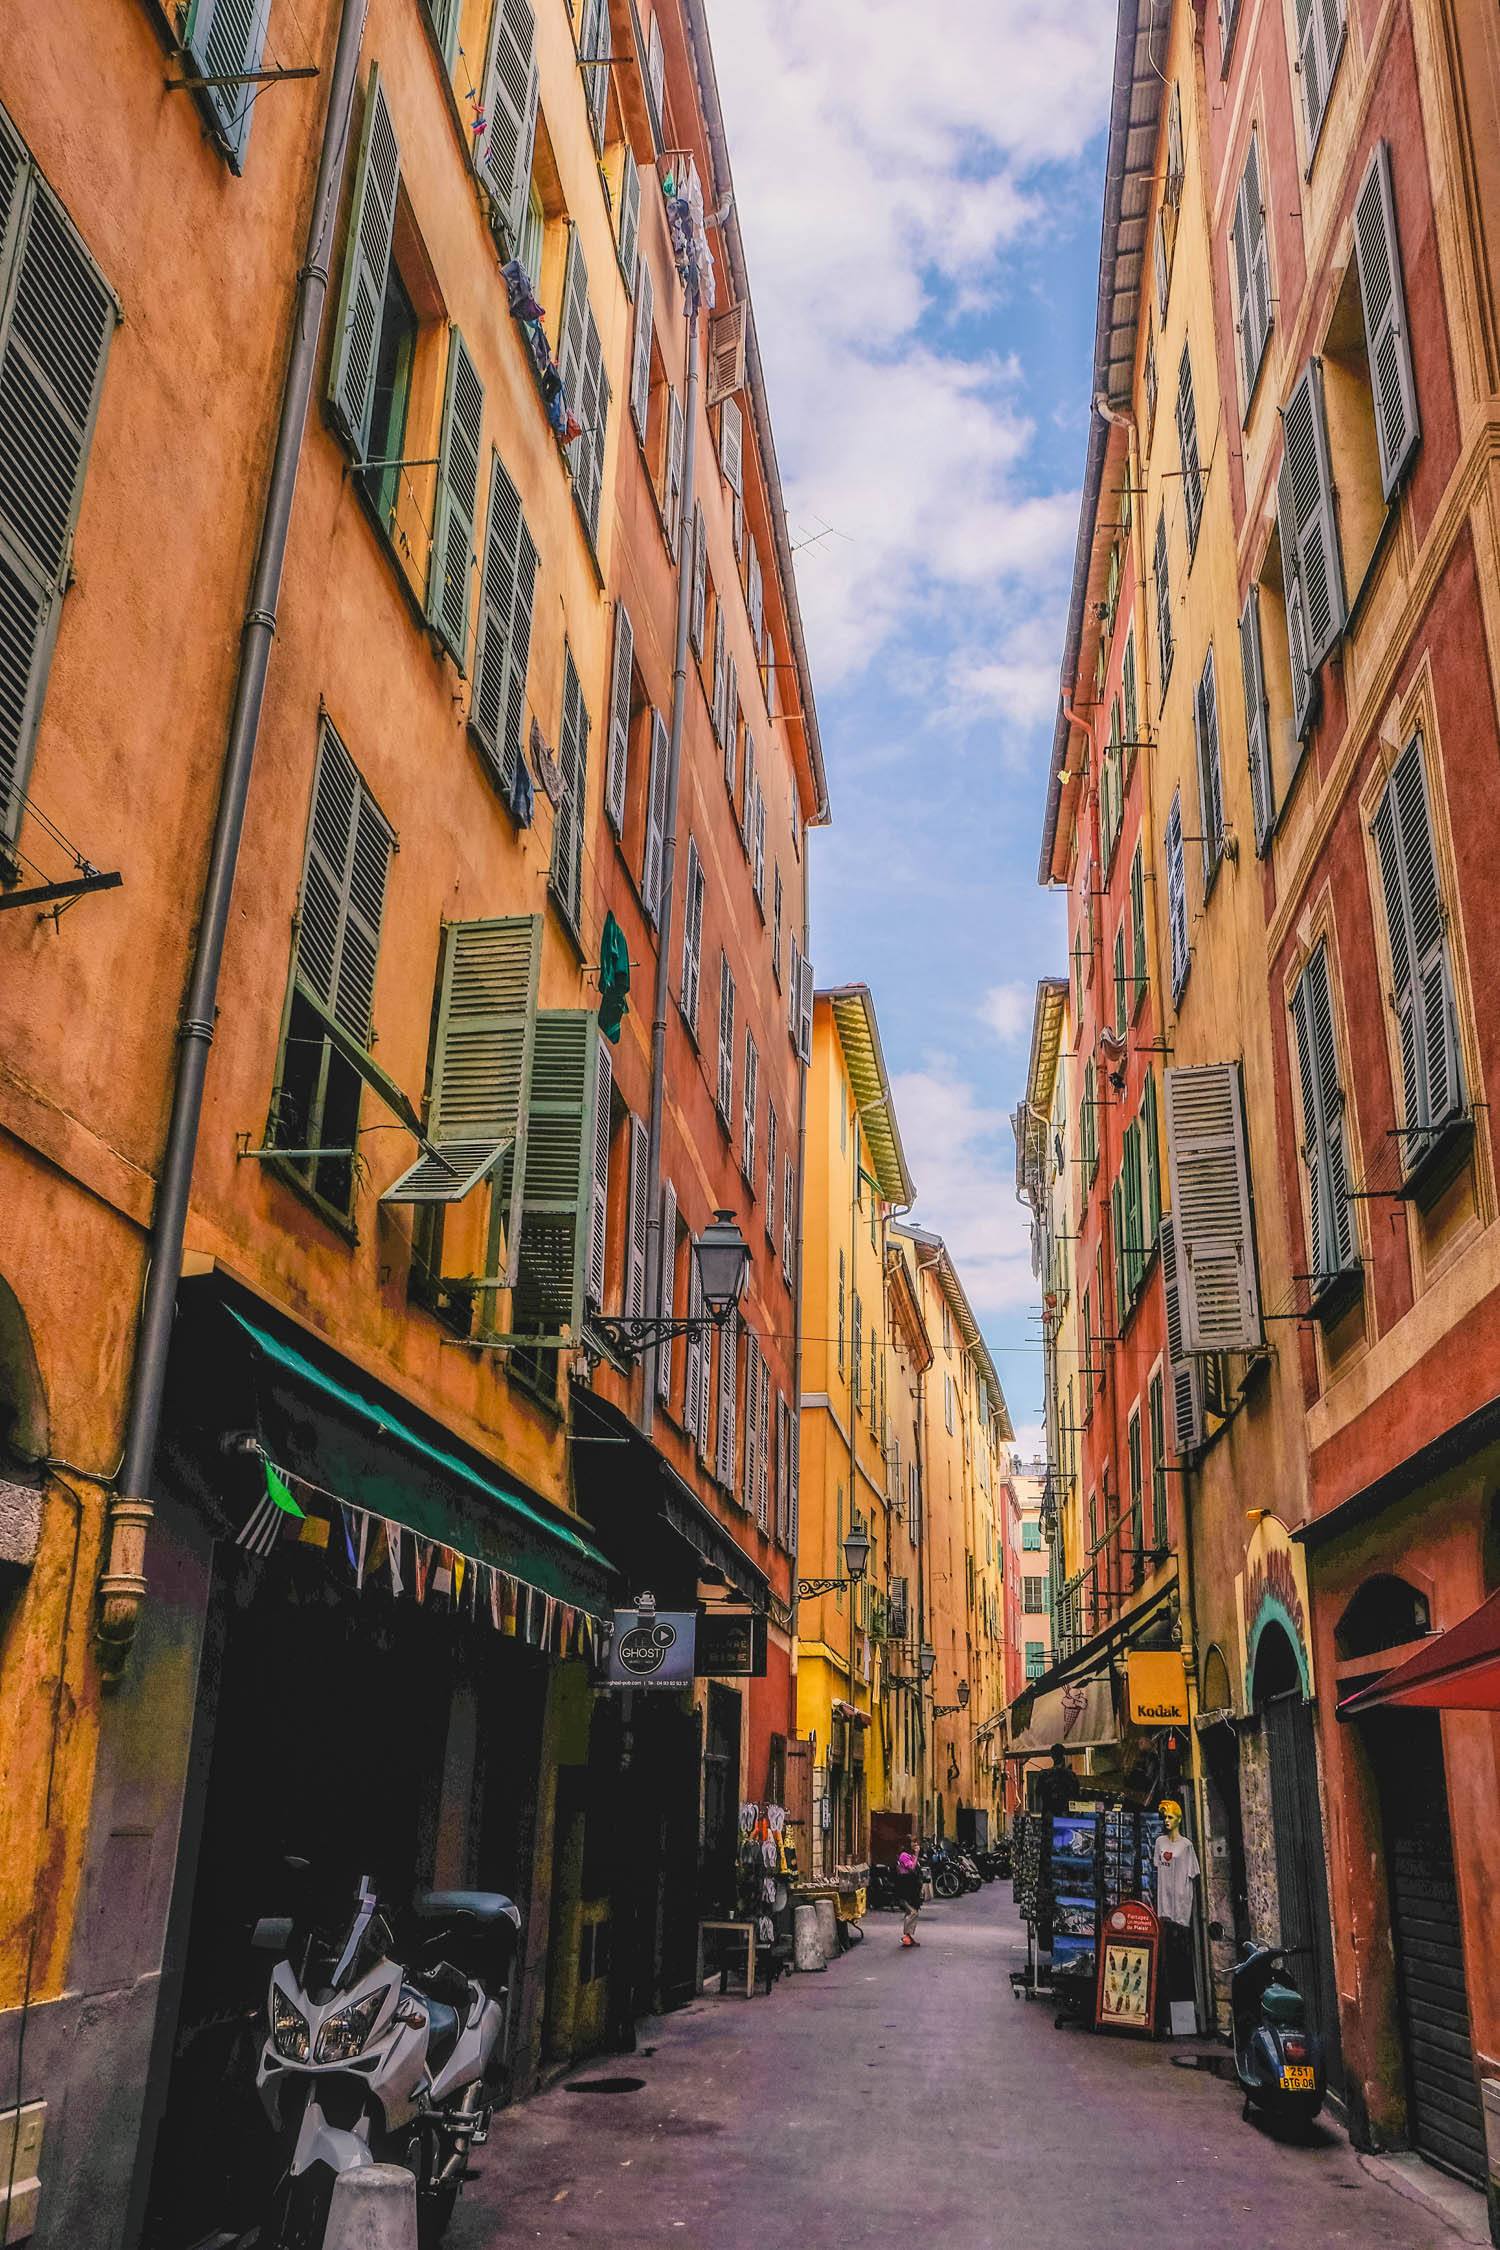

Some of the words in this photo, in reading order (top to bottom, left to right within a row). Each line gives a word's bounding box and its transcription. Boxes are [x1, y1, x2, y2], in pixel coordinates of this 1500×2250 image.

[634, 1637, 648, 1648] LE
[622, 1647, 661, 1658] GHOST
[1137, 1704, 1182, 1718] Kodak
[1290, 2067, 1308, 2076] 251
[1283, 2078, 1300, 2087] BTG
